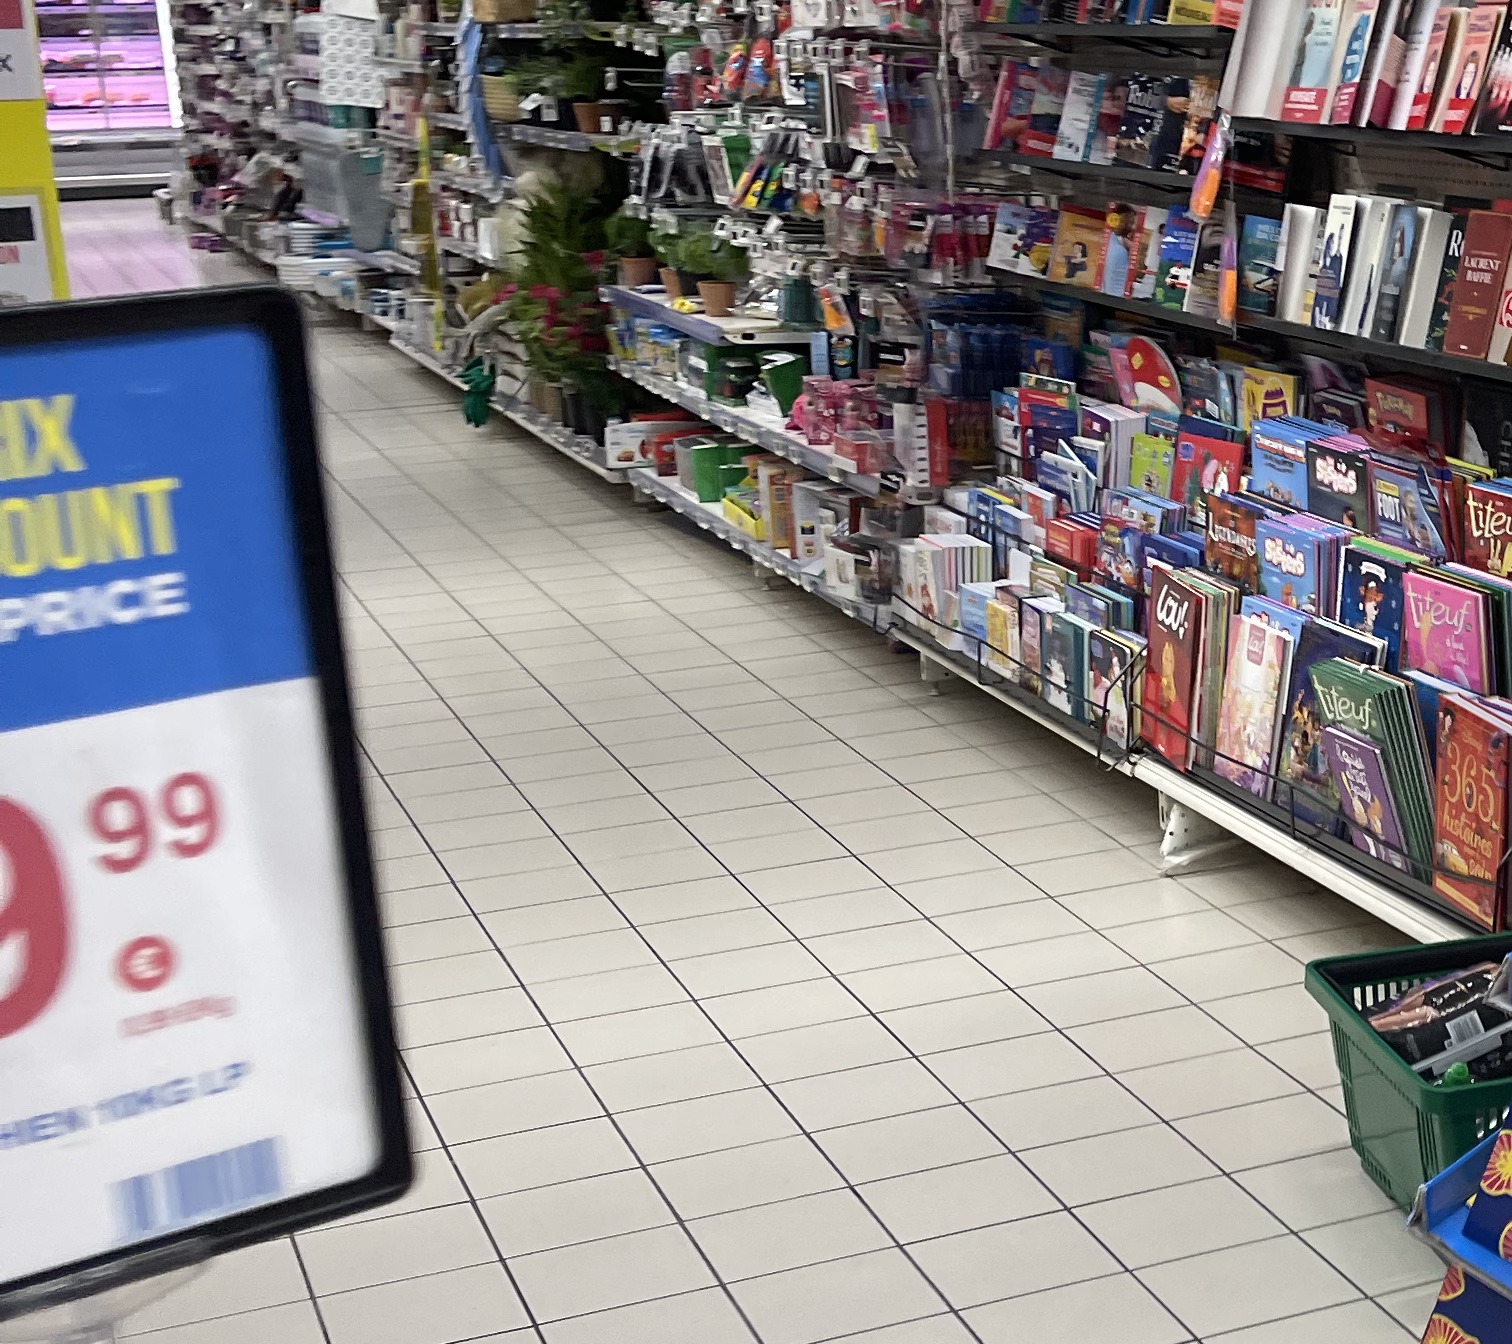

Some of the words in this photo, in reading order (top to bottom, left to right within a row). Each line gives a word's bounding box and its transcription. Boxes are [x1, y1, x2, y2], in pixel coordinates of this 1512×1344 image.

[87, 769, 225, 875] 99
[1444, 741, 1496, 823] 365
[1442, 801, 1493, 859] histoires
